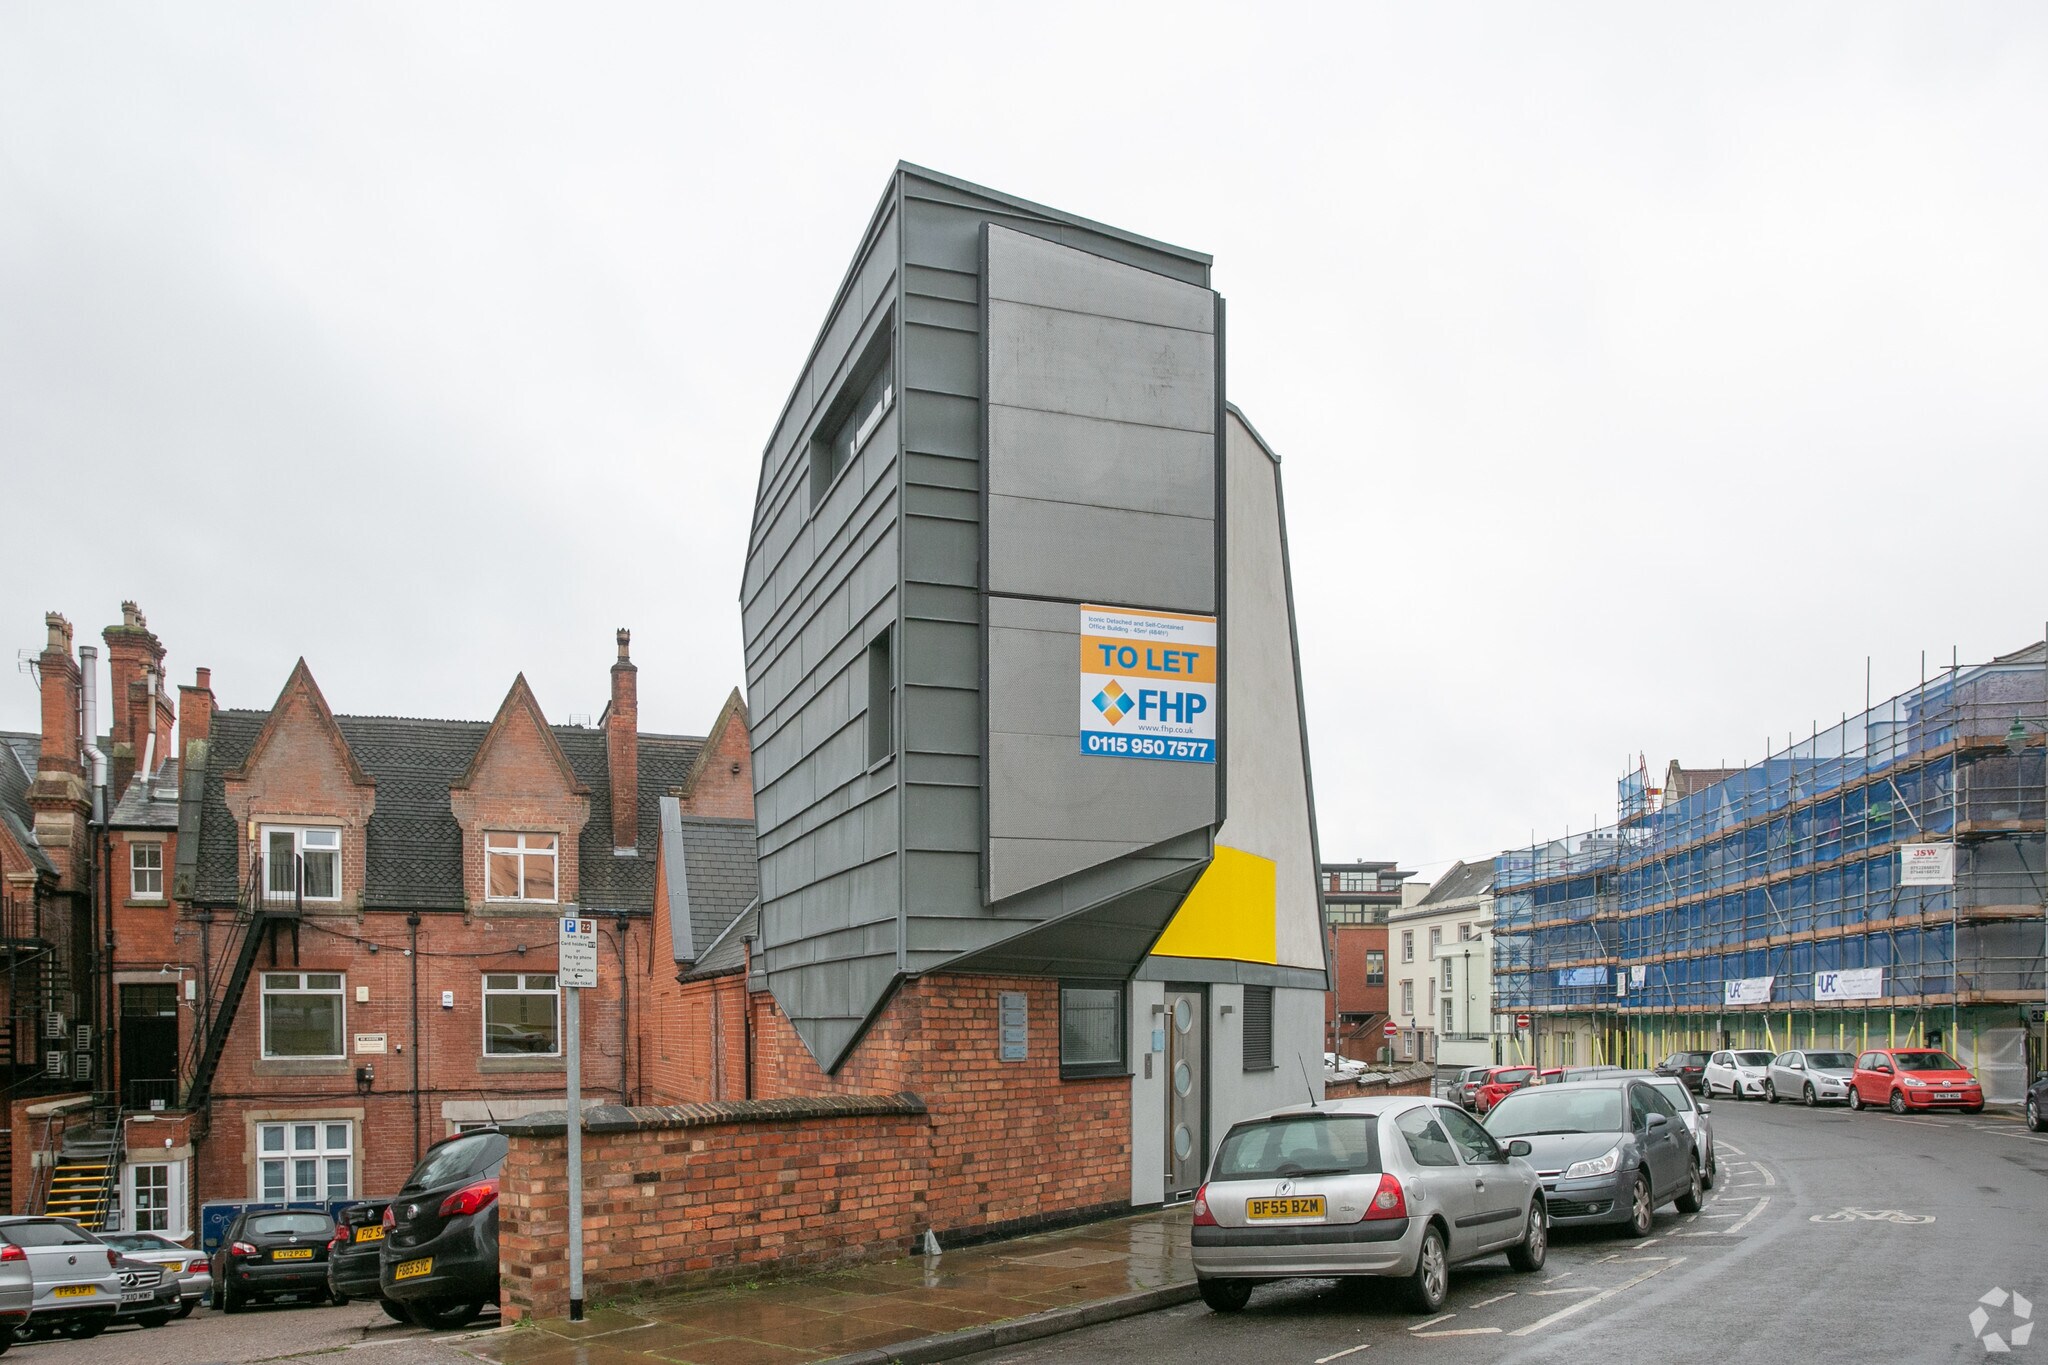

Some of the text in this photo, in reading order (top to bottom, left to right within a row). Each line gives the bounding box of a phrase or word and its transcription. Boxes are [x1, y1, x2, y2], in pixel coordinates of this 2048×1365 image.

[1106, 618, 1132, 626] Detached
[1145, 621, 1184, 631] Self-Contained
[1107, 625, 1129, 633] Building
[1098, 644, 1199, 674] TO LET
[1138, 689, 1207, 724] FHP
[1138, 724, 1194, 734] www.fhp.co.uk
[1088, 735, 1208, 758] 0115 950 7577
[1914, 849, 1937, 857] JSW
[566, 920, 575, 931] P
[1253, 1199, 1319, 1214] BF55 BZM
[415, 1259, 429, 1273] SYC
[59, 1285, 92, 1296] FP18 XPT
